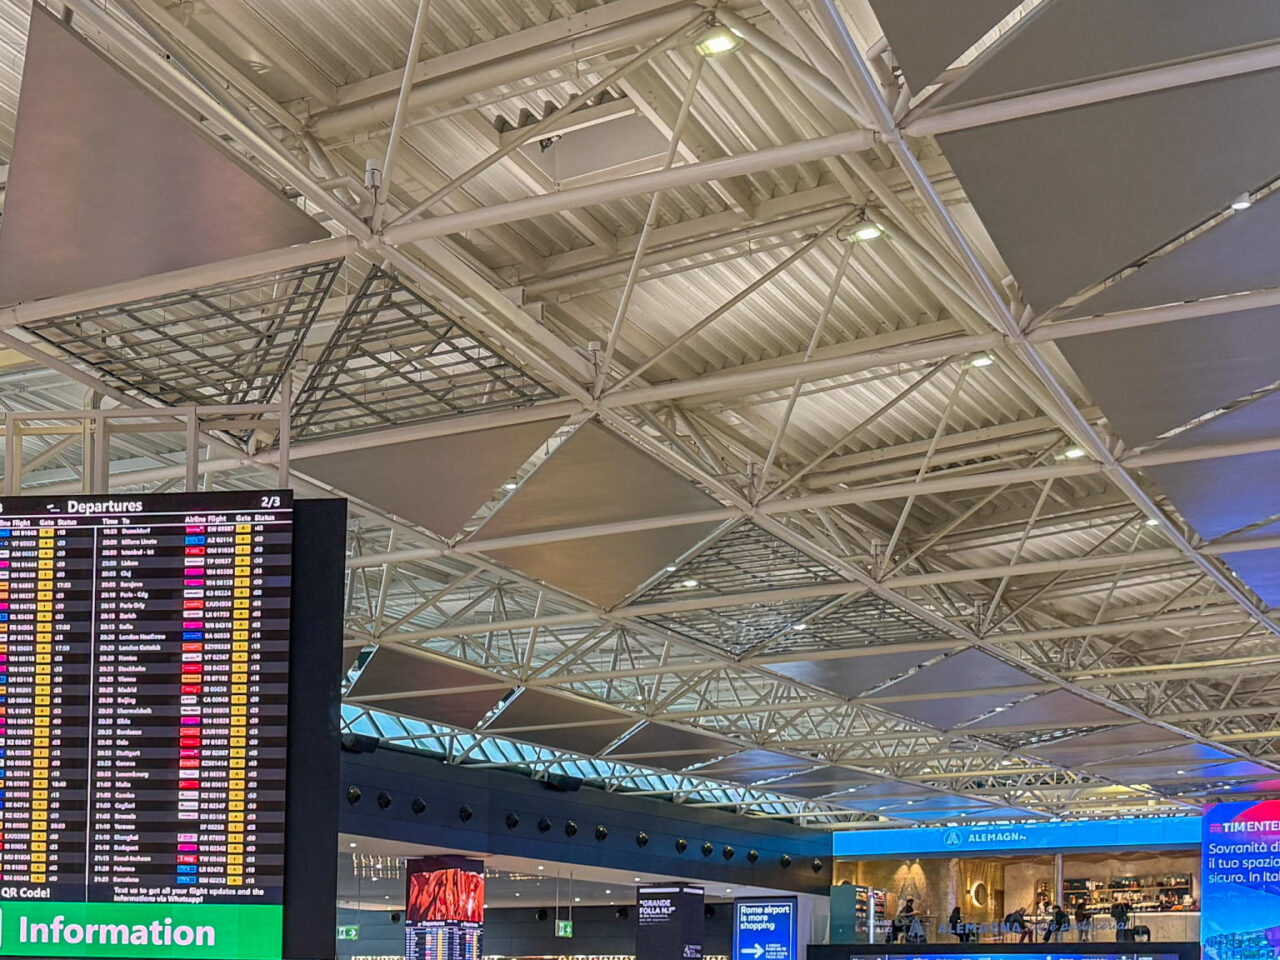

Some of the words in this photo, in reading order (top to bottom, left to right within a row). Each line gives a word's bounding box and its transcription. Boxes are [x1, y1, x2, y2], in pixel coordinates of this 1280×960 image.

[67, 500, 143, 515] Departures
[261, 496, 281, 507] 2/3
[12, 519, 31, 527] Flight
[102, 517, 118, 525] Time
[122, 517, 130, 525] To
[185, 515, 206, 523] Airline
[207, 515, 227, 523] Flight
[1222, 822, 1245, 833] TIM
[1247, 820, 1280, 832] ENTE
[1208, 841, 1267, 854] Sovranità
[1208, 857, 1215, 869] il
[1219, 858, 1239, 869] tuo
[1242, 855, 1280, 870] spazio
[1208, 871, 1246, 883] sicuro.
[1249, 871, 1260, 882] In
[1, 887, 18, 899] QR
[20, 887, 51, 898] Code!
[149, 888, 160, 896] get
[162, 887, 170, 895] all
[172, 888, 187, 896] your
[189, 887, 208, 896] flight
[209, 888, 236, 896] updates
[252, 888, 264, 896] the
[741, 906, 763, 914] Rome
[764, 906, 790, 915] airport
[19, 915, 215, 947] Information
[740, 922, 775, 931] shopping
